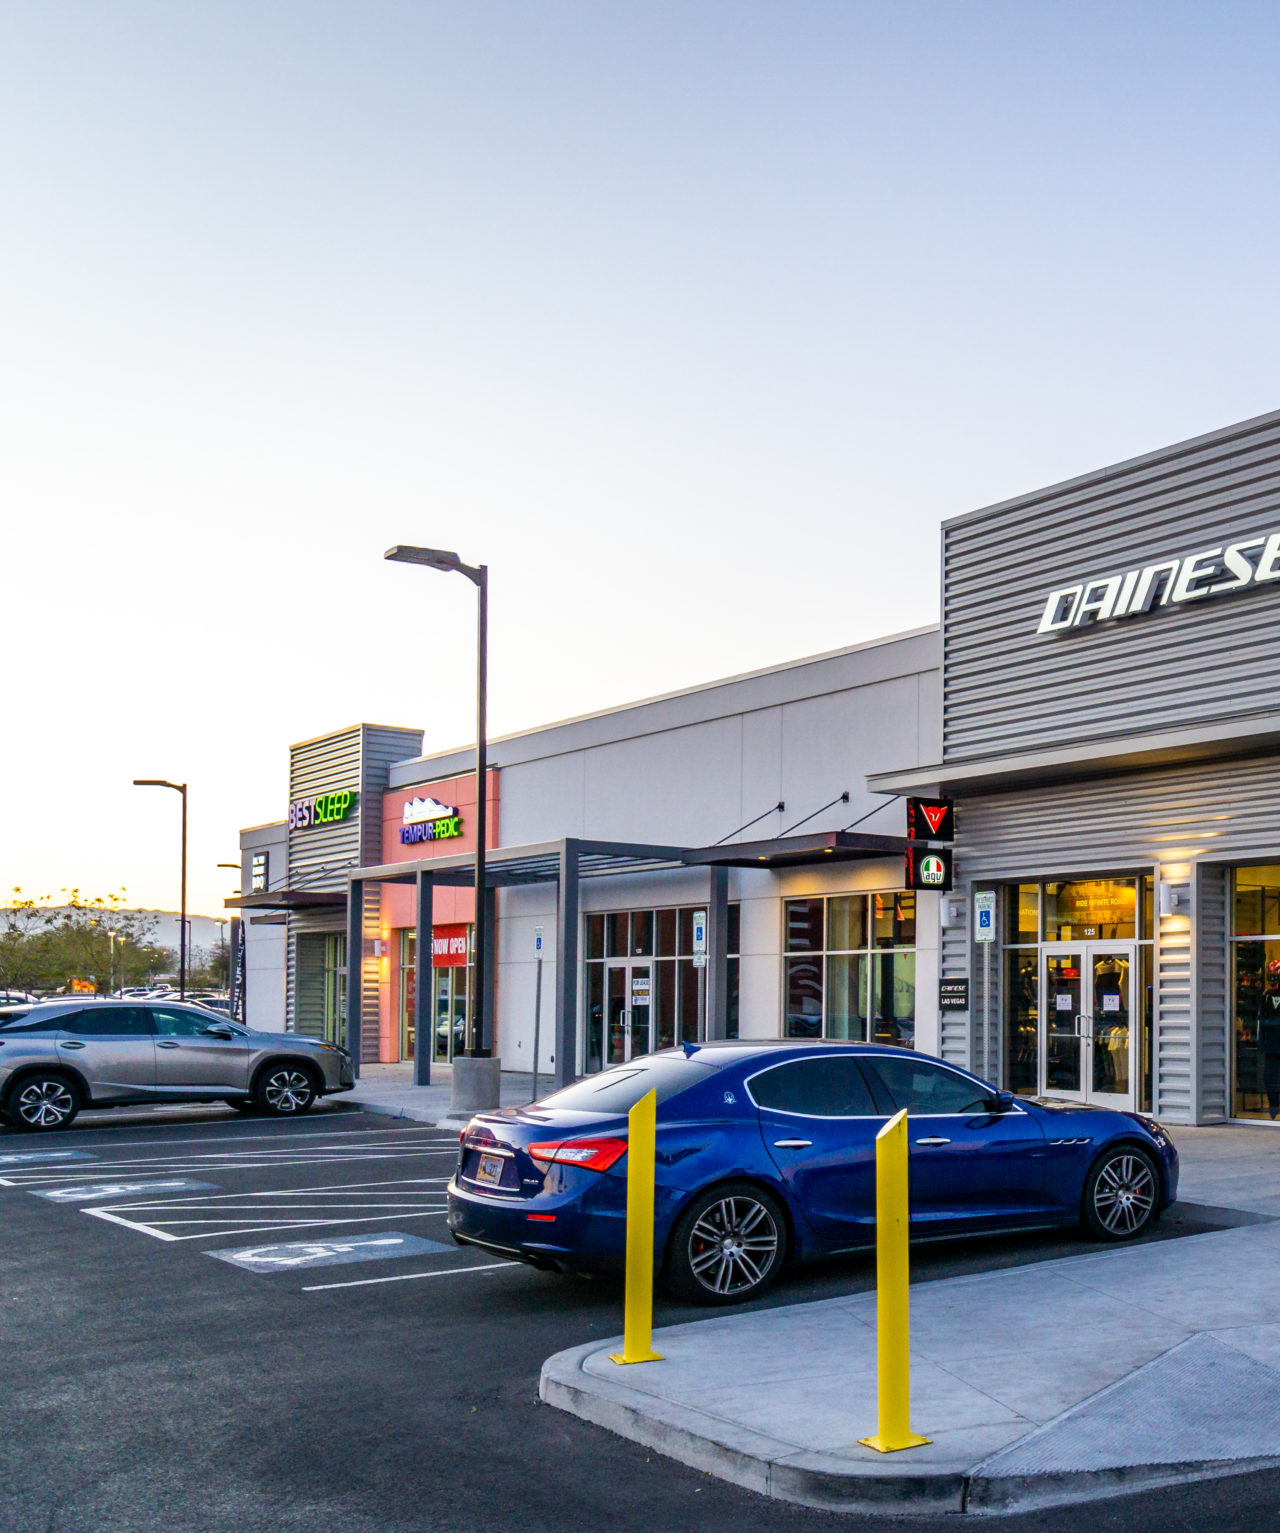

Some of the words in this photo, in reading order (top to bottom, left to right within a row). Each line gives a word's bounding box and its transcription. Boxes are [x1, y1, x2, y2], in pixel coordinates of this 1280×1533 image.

[399, 817, 459, 844] TEMPUR-PEDIC
[1084, 928, 1096, 936] 125
[433, 939, 449, 955] NOW
[449, 937, 466, 954] OPEN
